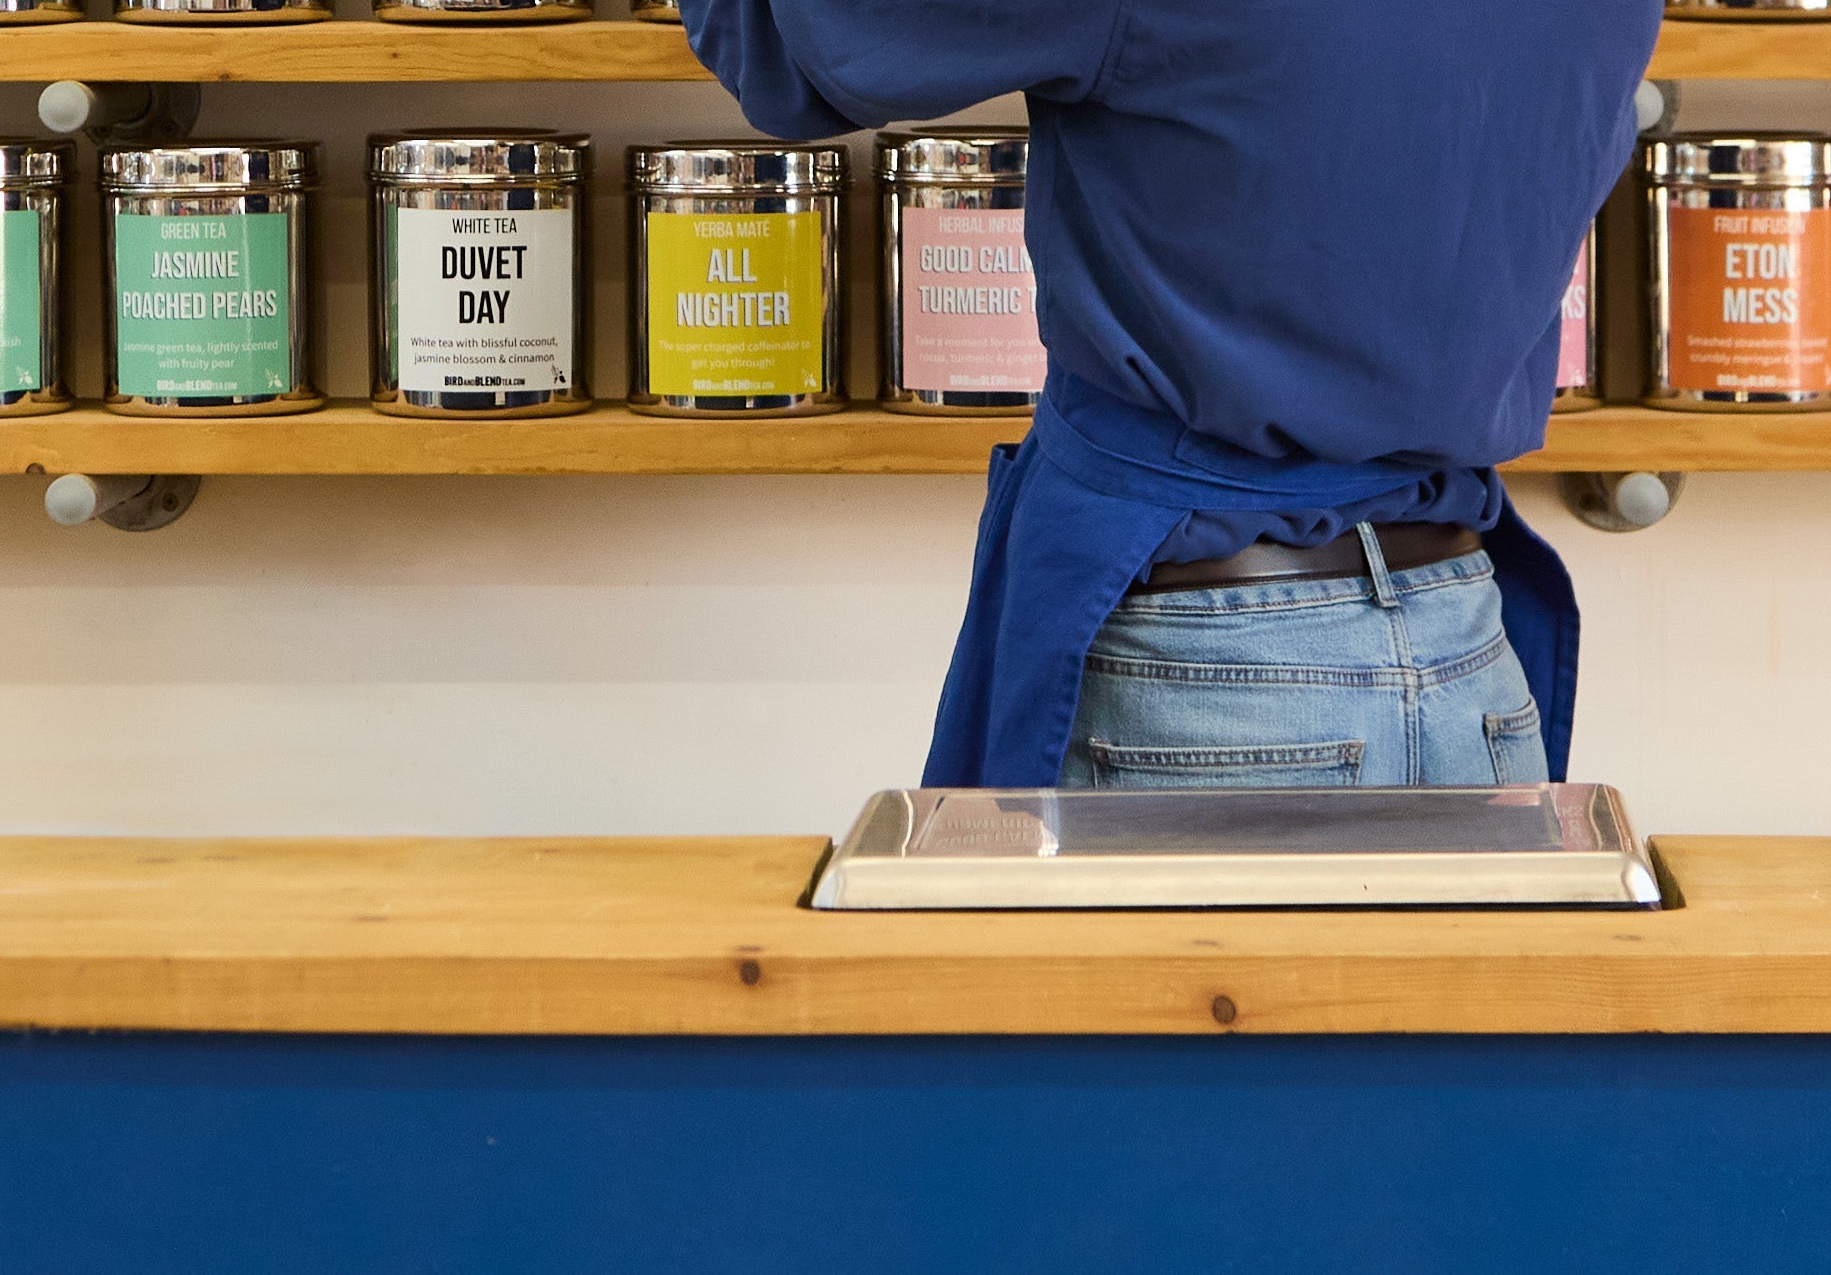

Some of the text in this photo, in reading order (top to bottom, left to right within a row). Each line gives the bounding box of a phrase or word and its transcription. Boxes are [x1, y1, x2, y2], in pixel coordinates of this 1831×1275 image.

[453, 218, 517, 233] WHITE TEA
[694, 221, 734, 238] YERBA
[151, 249, 239, 280] JASMINE
[442, 246, 527, 279] DUVET
[707, 248, 757, 284] ALL
[919, 245, 970, 274] GOOD
[1725, 243, 1795, 280] ETON
[122, 289, 278, 319] POACHED PEARS
[459, 290, 510, 323] DAY
[676, 292, 790, 328] NIGHTER
[919, 287, 1025, 315] TURMERIC
[1723, 287, 1798, 325] MESS
[411, 337, 517, 347] White tea with blissful
[453, 353, 554, 364] blossom cinnamon
